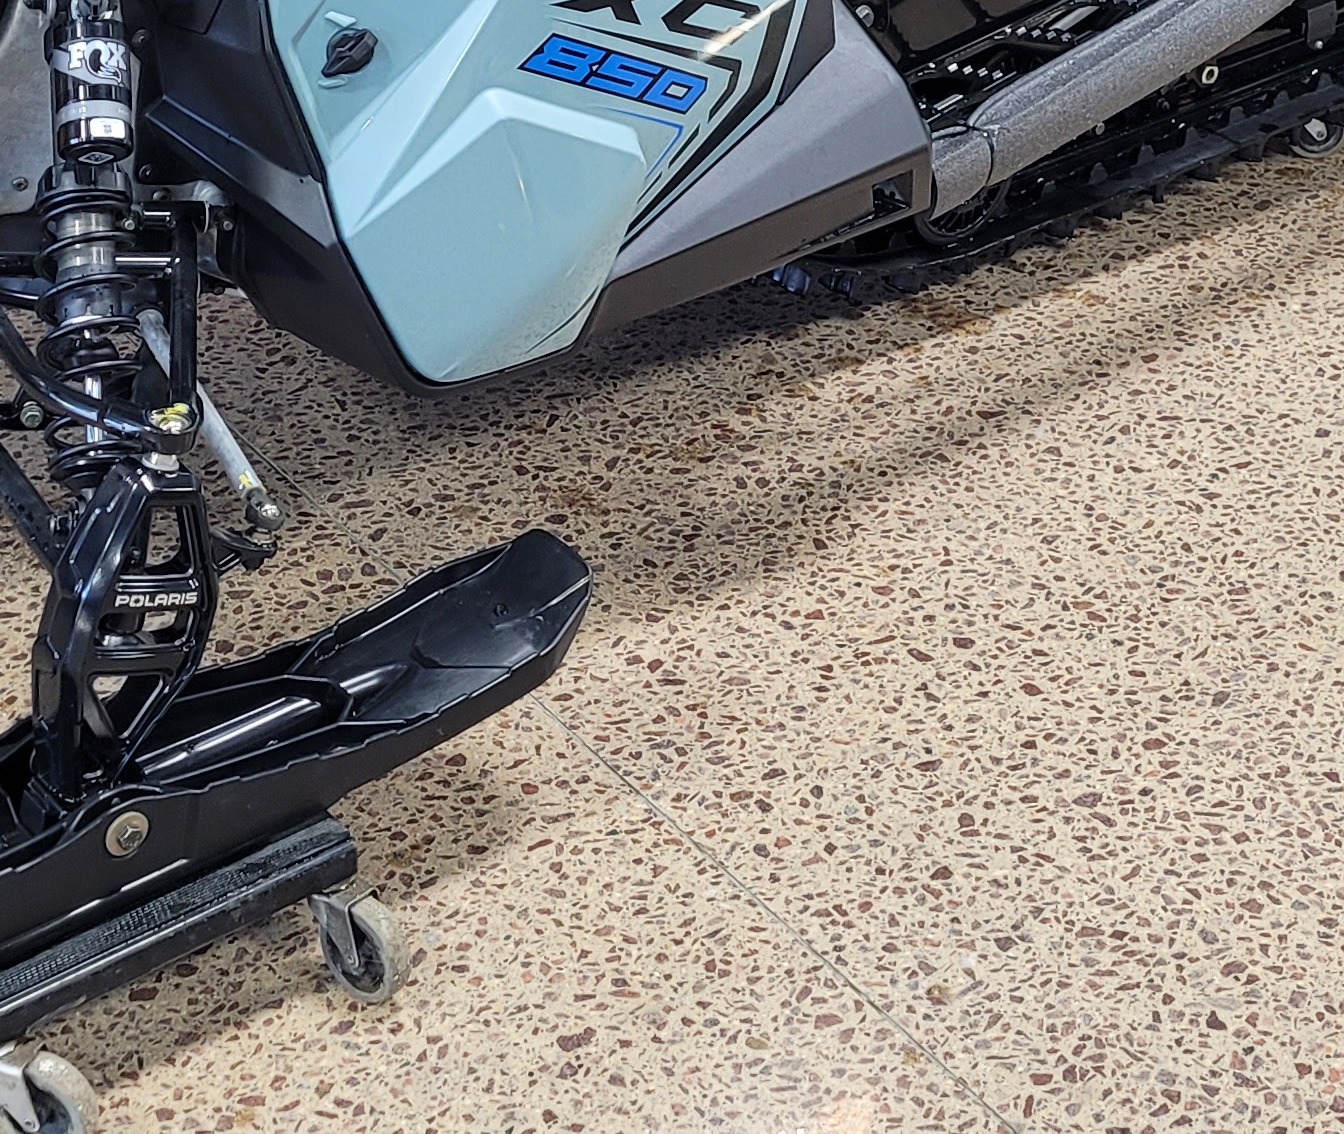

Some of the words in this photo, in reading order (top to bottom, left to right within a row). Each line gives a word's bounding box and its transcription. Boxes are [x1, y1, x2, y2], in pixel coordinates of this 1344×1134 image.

[67, 39, 127, 78] FOX
[515, 32, 709, 115] 850
[114, 591, 198, 607] POLARIS
